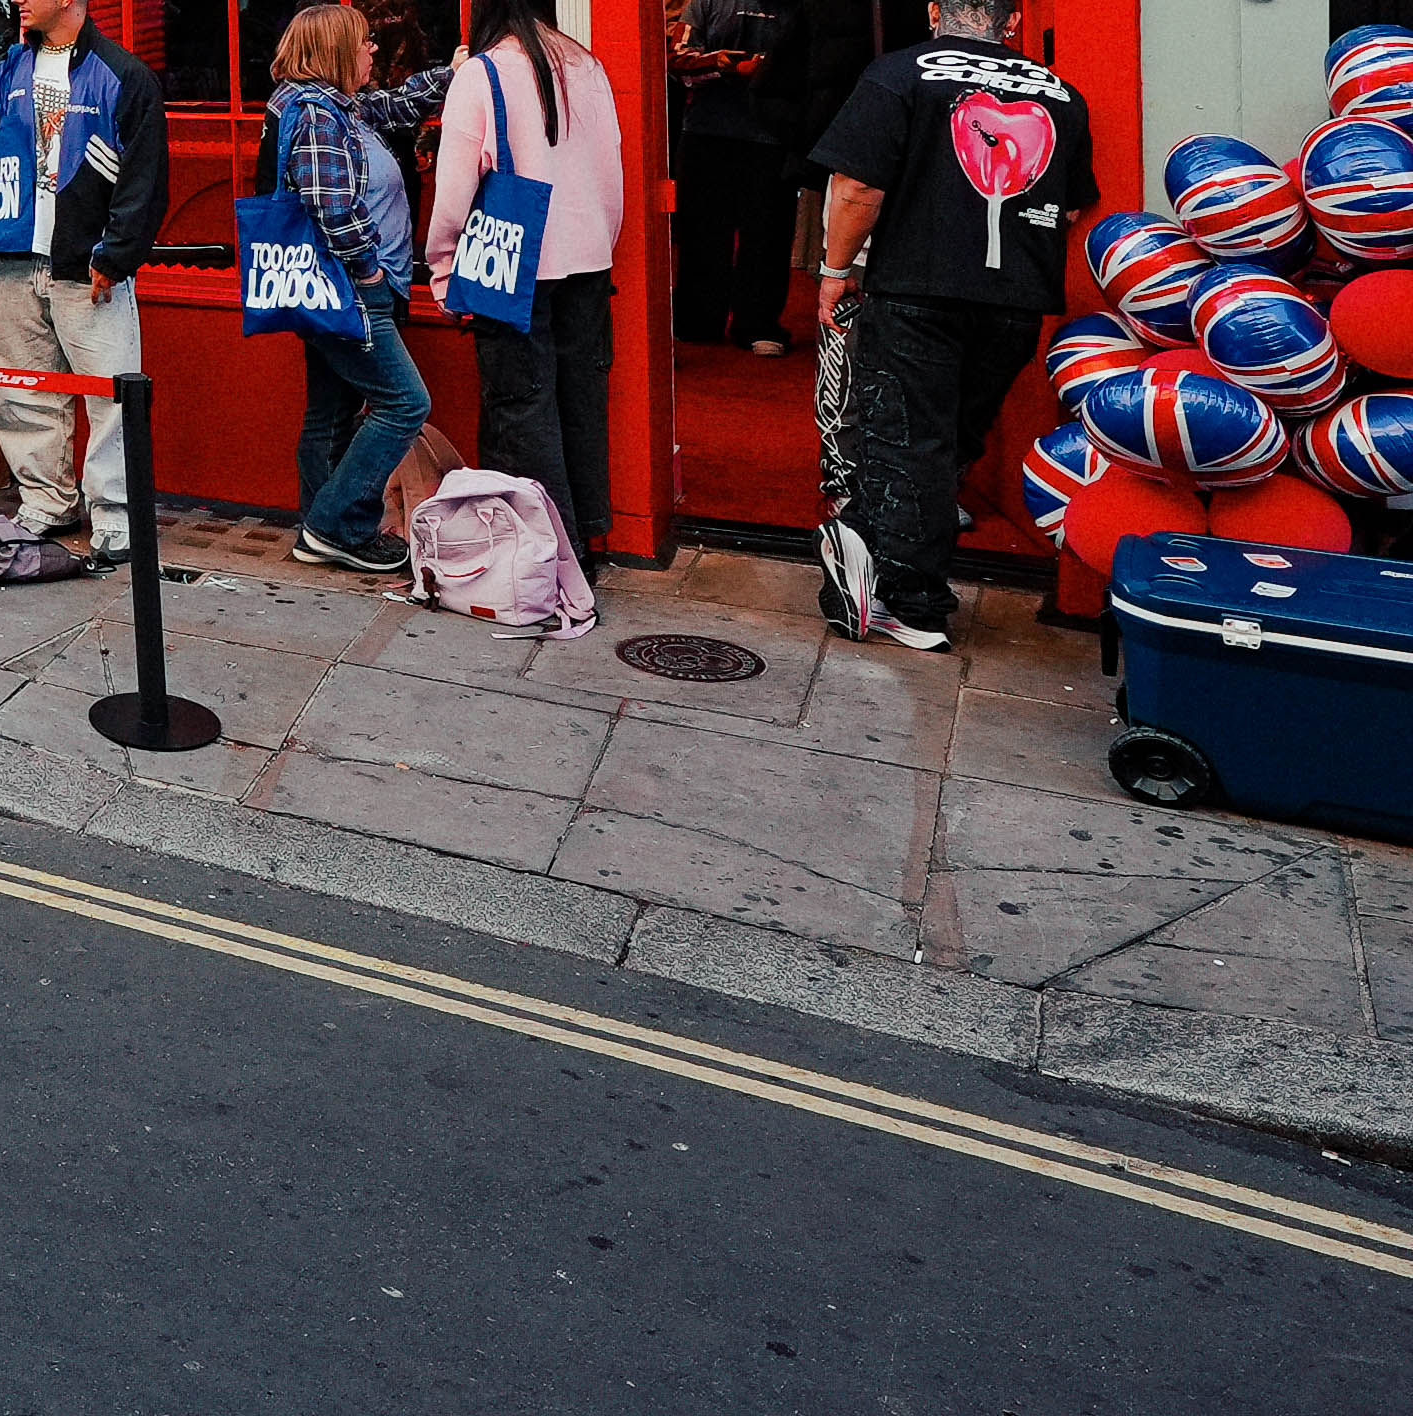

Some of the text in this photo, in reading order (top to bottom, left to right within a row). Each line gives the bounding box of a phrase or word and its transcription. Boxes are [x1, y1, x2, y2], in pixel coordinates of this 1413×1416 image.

[0, 156, 20, 183] FOR
[493, 220, 524, 253] FOR
[251, 243, 283, 271] TOO
